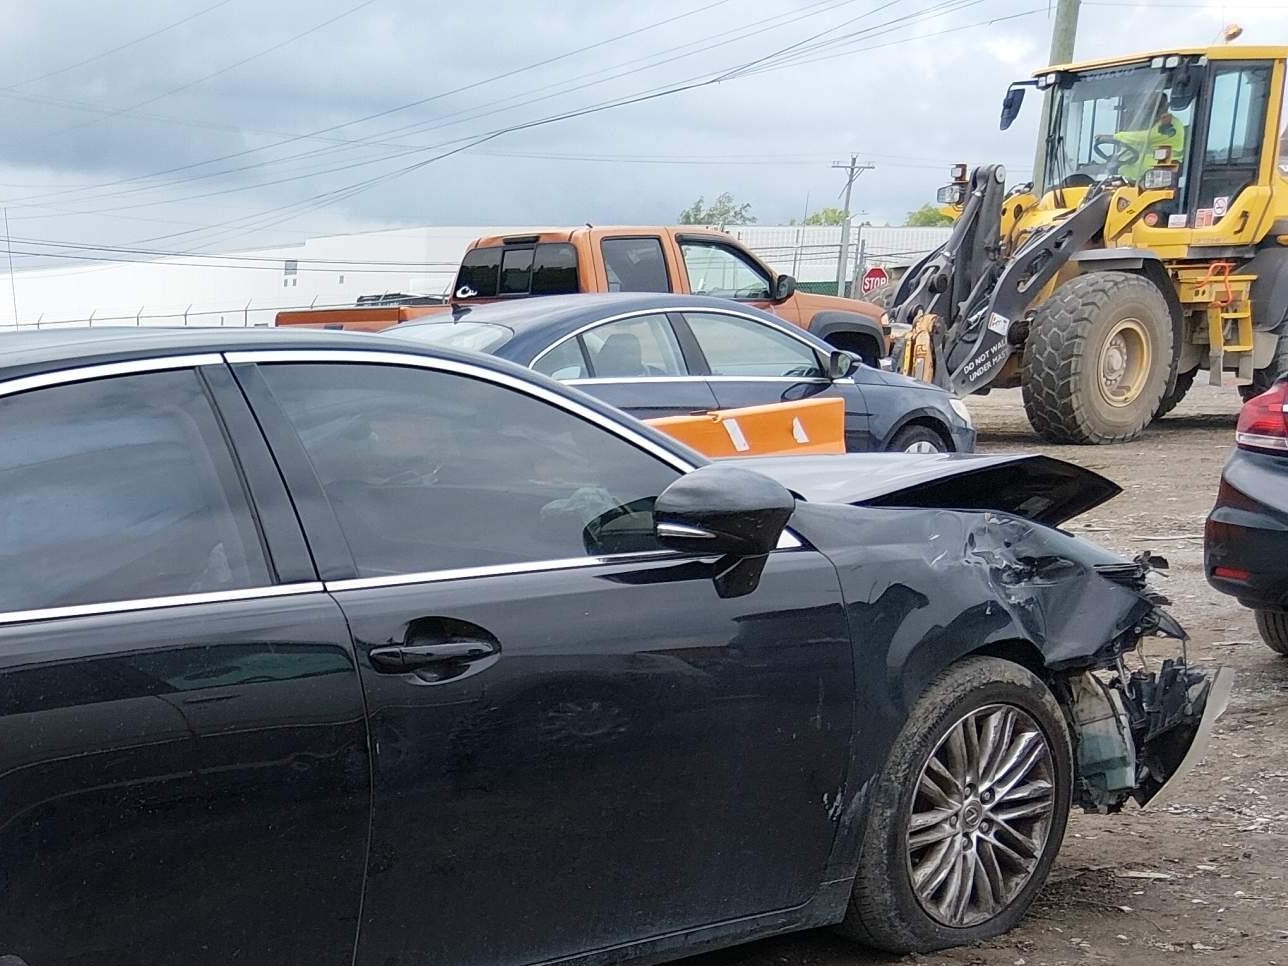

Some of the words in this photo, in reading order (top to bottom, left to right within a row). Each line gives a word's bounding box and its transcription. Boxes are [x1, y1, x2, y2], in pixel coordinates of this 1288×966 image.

[864, 277, 886, 290] STOP
[963, 361, 975, 375] DO
[974, 350, 990, 366] NOT
[990, 336, 1008, 354] WAL
[969, 360, 992, 381] UNDER
